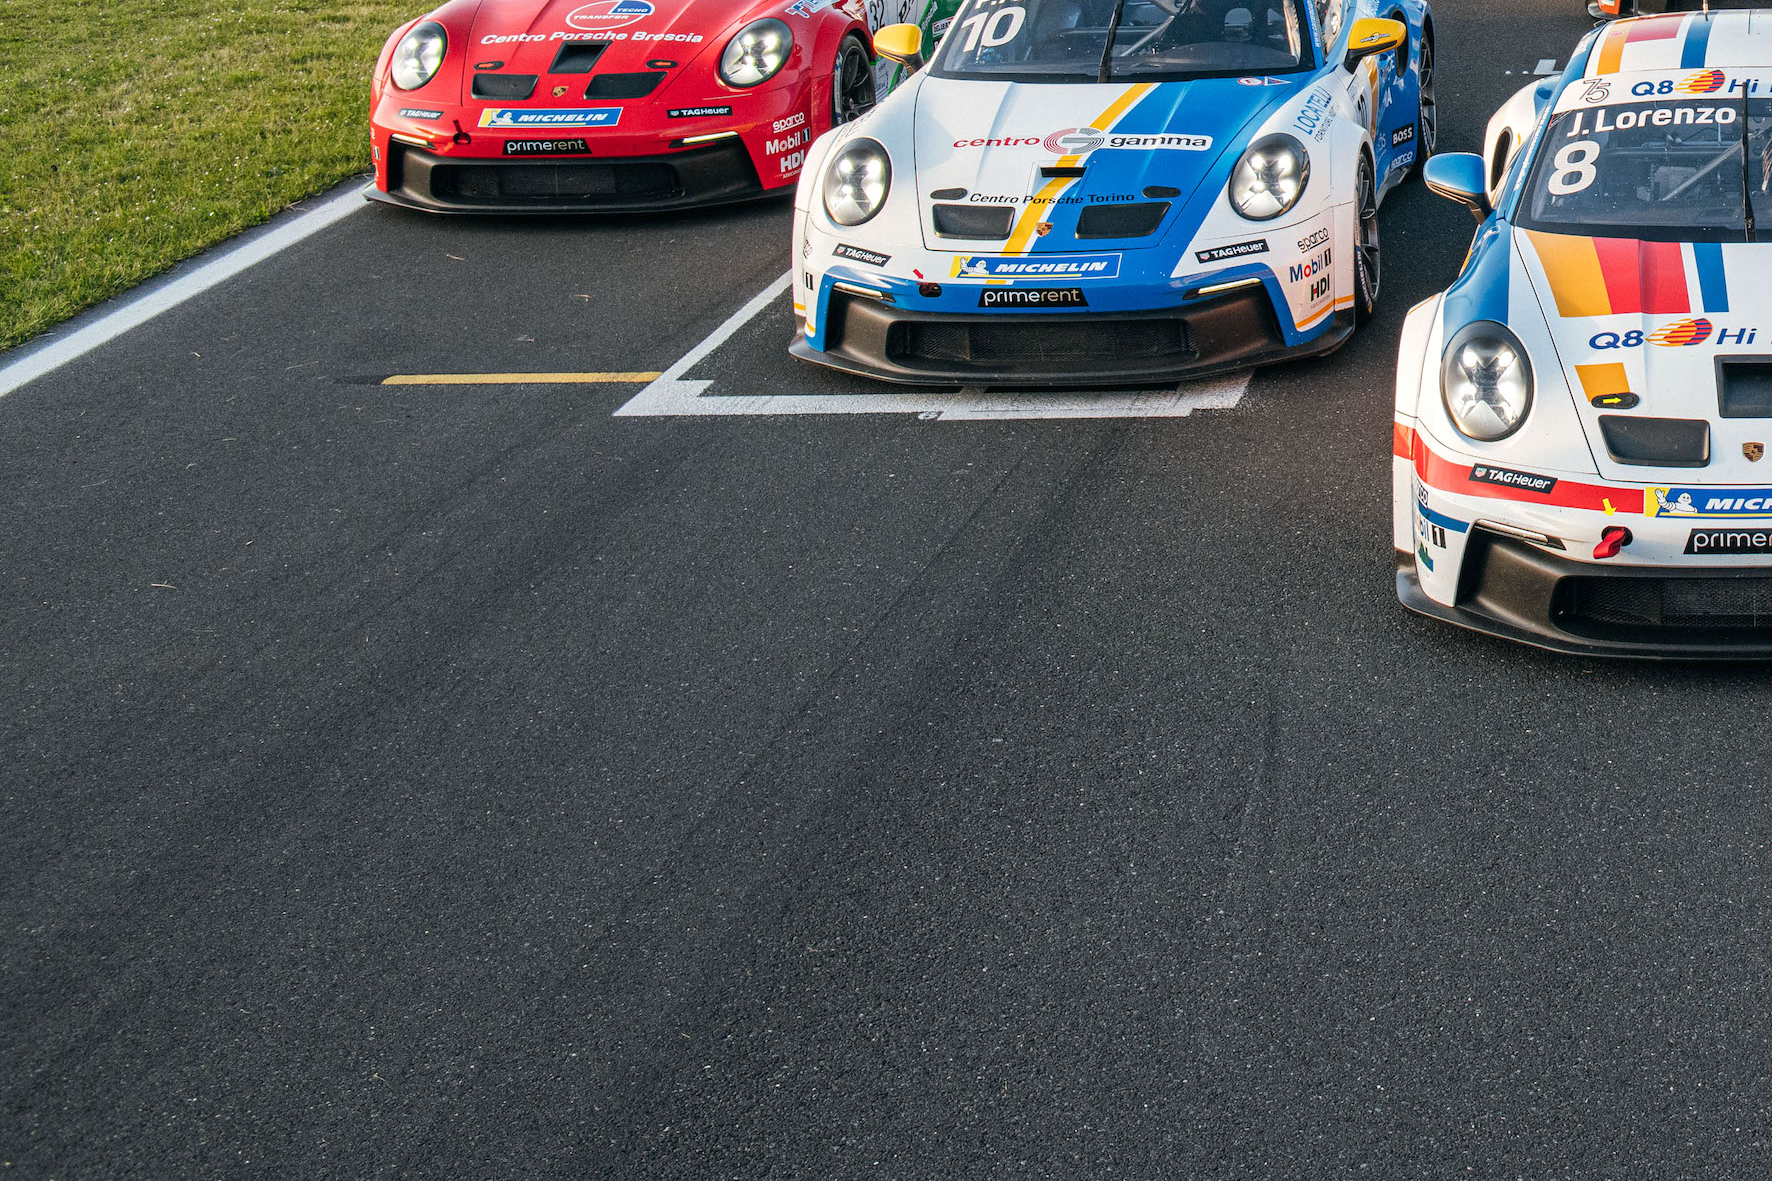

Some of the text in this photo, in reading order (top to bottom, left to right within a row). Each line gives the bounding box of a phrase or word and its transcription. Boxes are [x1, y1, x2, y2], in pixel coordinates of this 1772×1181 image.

[481, 30, 704, 46] Centro Porsche Brescia
[960, 6, 1028, 54] 10
[1582, 78, 1612, 104] 75
[1631, 80, 1674, 98] Q8
[1728, 78, 1759, 94] Hi
[518, 112, 609, 122] MICHELIN
[1293, 86, 1333, 136] LOCATELLI
[1595, 106, 1737, 132] Lorenzo
[772, 112, 805, 132] sparco
[766, 132, 801, 156] Mobil
[953, 134, 1206, 150] centro gamma
[1392, 127, 1412, 144] BOSS
[506, 140, 586, 154] primerent
[780, 149, 805, 173] HDI
[1548, 140, 1600, 196] 8
[970, 192, 1134, 205] Centro Porsche Torino
[1210, 242, 1264, 259] TAGHeuer
[1297, 228, 1329, 252] sparco
[846, 247, 887, 265] TAGHeuer
[994, 260, 1107, 274] MICHELIN
[1290, 254, 1324, 283] Mobil
[984, 288, 1079, 306] primerent
[1310, 274, 1330, 302] HDI
[1588, 329, 1644, 350] Q8
[1716, 328, 1757, 346] Hi
[1488, 469, 1552, 490] TAGHeuer
